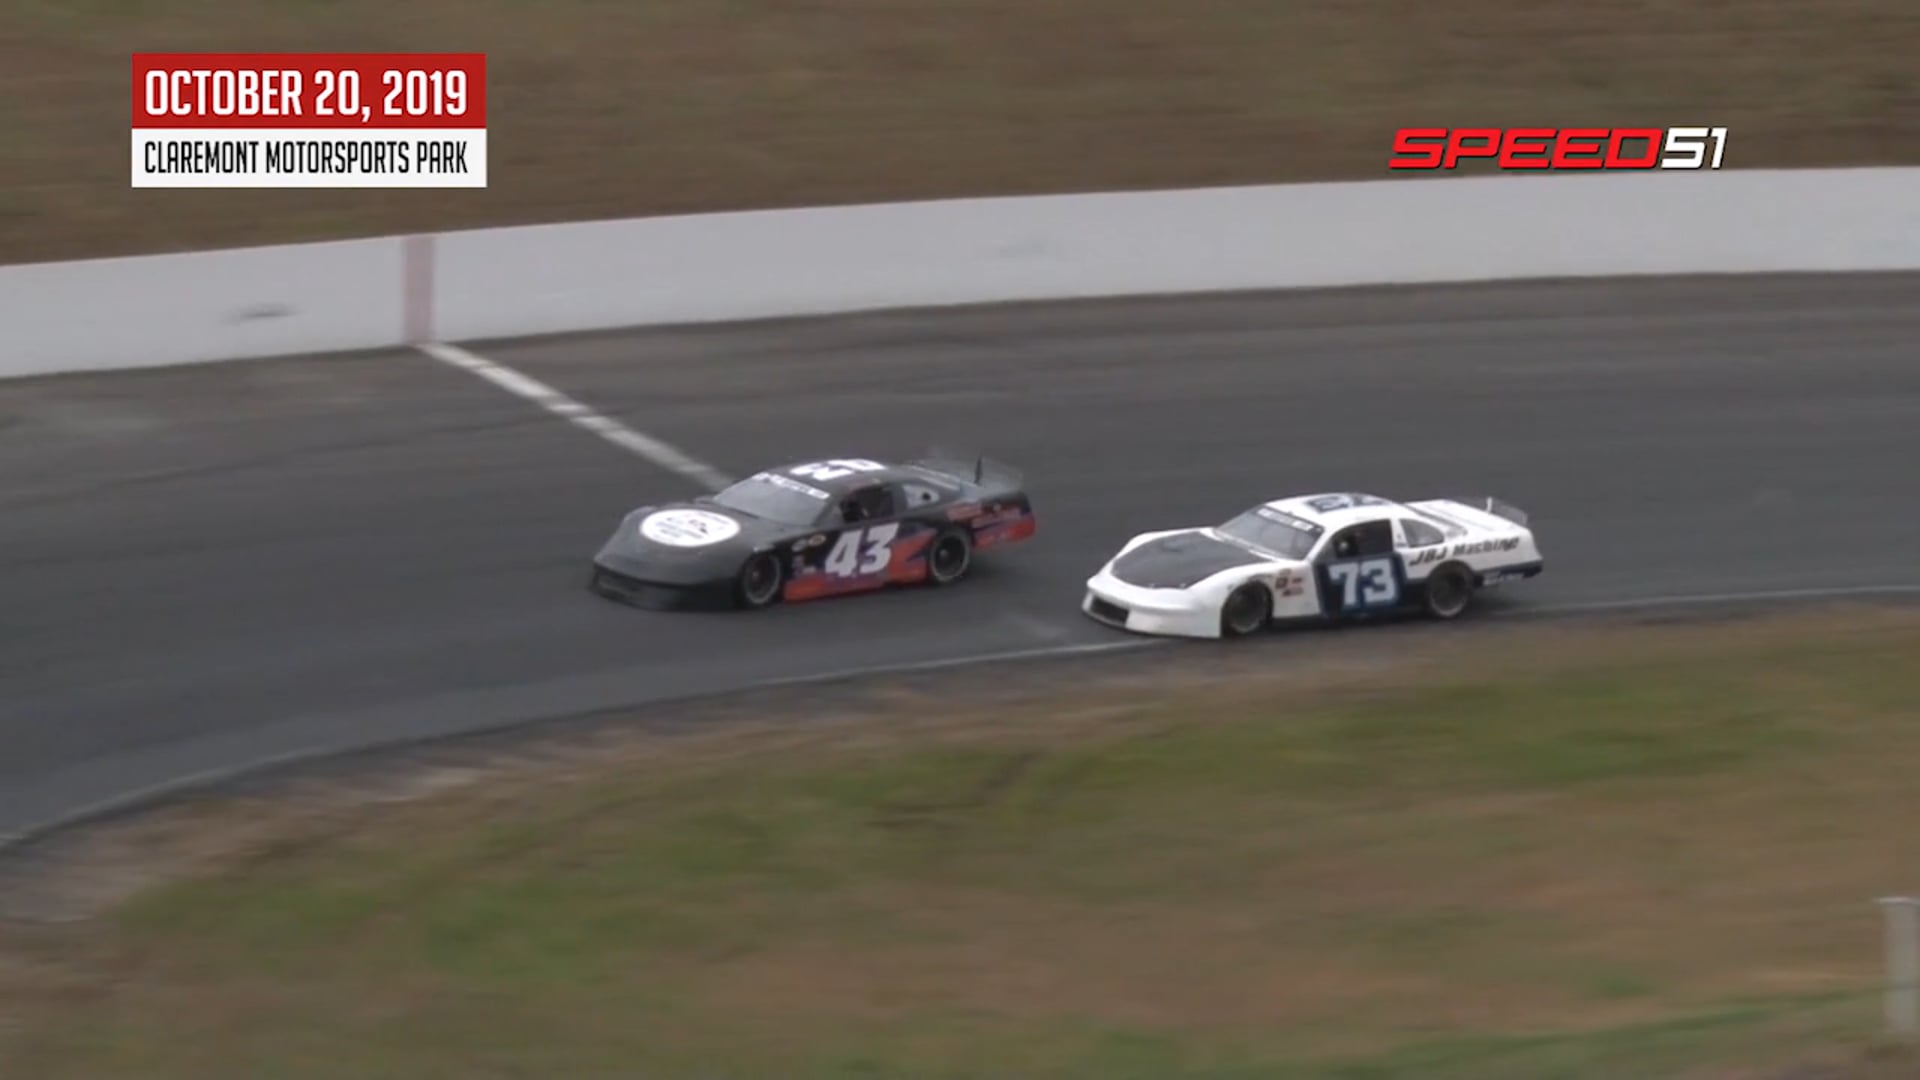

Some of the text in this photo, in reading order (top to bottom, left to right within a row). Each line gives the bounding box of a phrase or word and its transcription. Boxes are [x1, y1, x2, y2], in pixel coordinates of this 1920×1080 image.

[825, 523, 899, 578] 43
[1451, 535, 1520, 557] Machine
[1328, 558, 1396, 606] 73
